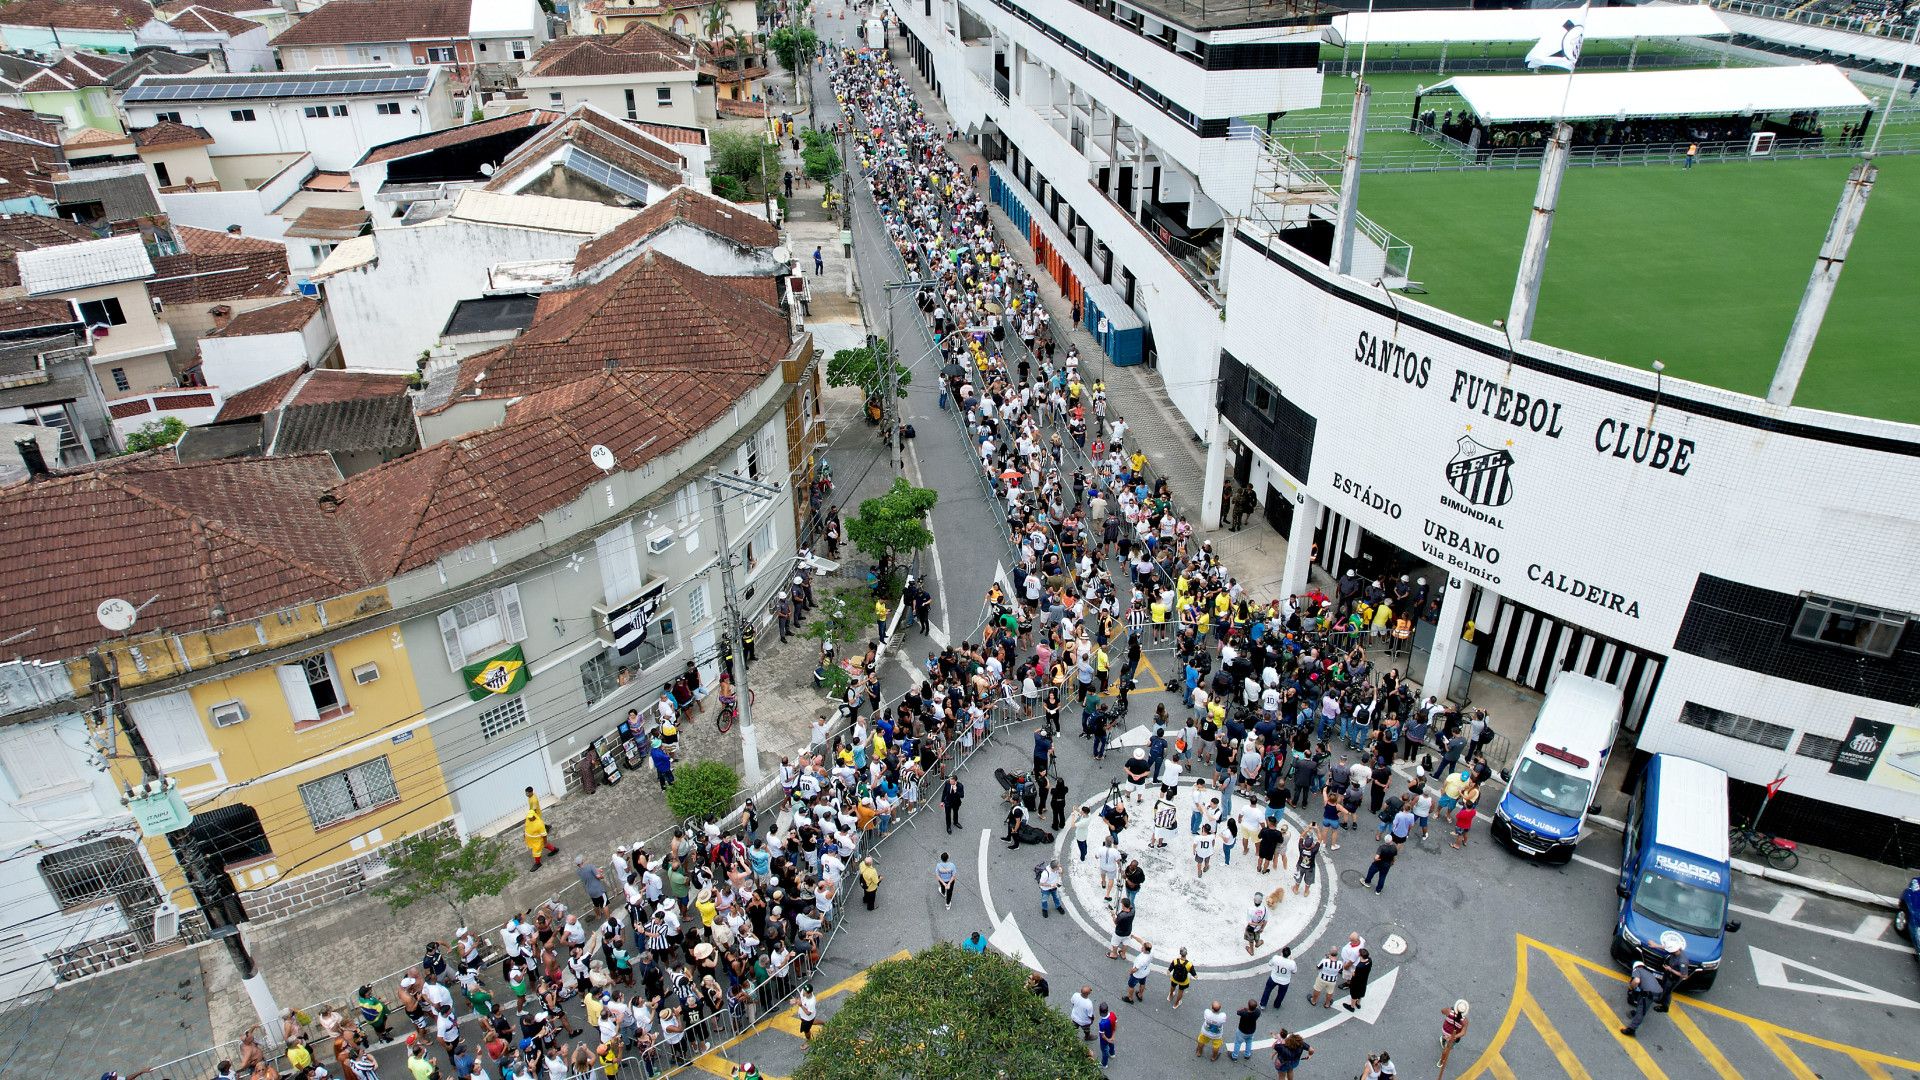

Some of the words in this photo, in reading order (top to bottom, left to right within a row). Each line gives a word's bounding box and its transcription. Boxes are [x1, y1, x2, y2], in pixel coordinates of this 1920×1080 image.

[1355, 330, 1432, 389] SANTOS
[1450, 369, 1563, 440] FUTEBOL
[1595, 417, 1696, 476] CLUBE
[1440, 495, 1504, 529] BIMUNDIAL
[1332, 472, 1402, 520] ESTÁDIO
[1423, 518, 1500, 565] URBANO
[1527, 563, 1641, 619] CALDEIRA
[1421, 541, 1444, 561] Vila
[1448, 553, 1501, 585] Belmiro
[1200, 841, 1210, 849] 10
[1656, 855, 1721, 880] GUARDA
[1276, 965, 1288, 975] 10
[689, 1013, 700, 1022] 10
